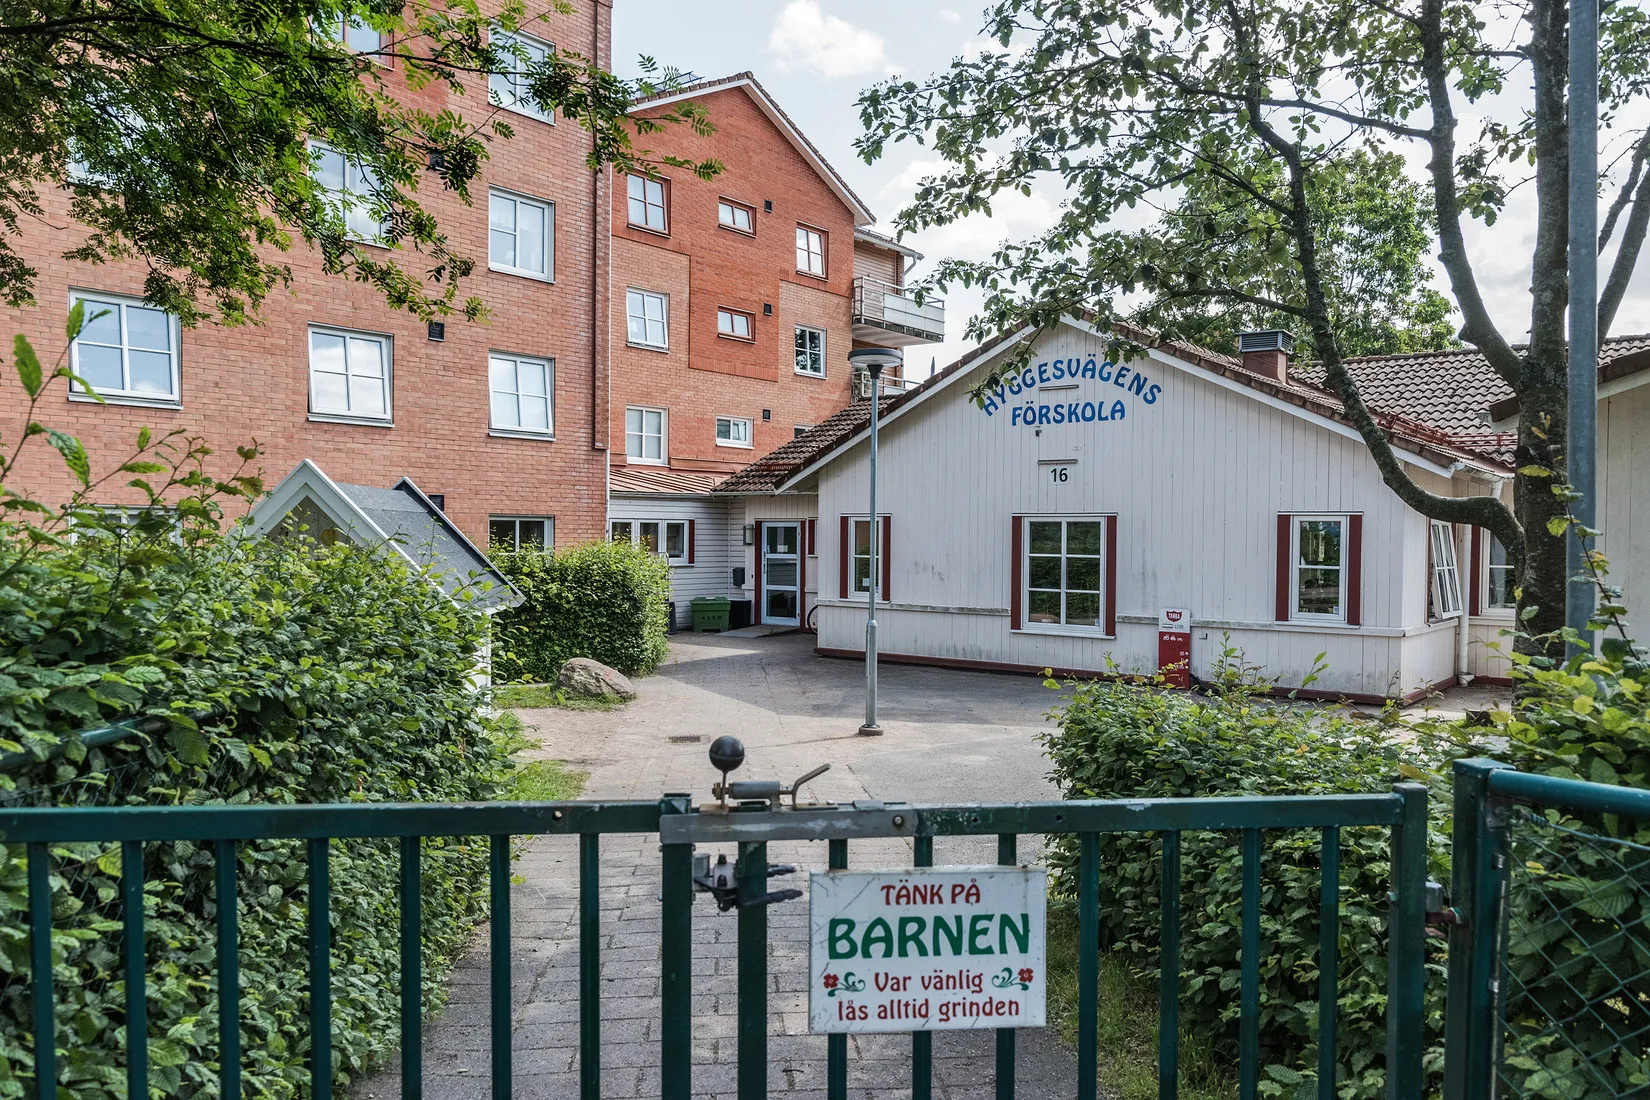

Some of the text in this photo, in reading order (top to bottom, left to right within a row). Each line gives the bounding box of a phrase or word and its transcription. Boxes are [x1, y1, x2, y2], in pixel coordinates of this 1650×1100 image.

[983, 353, 1162, 417] HYGGESVÄGENS
[1011, 399, 1126, 426] FÖRSKOLA
[1050, 468, 1069, 483] 16
[880, 878, 981, 906] TÄNK PÅ
[827, 913, 1030, 960] BARNEN
[874, 969, 984, 994] Var vänlig
[838, 996, 1020, 1023] lås alltid grinden
